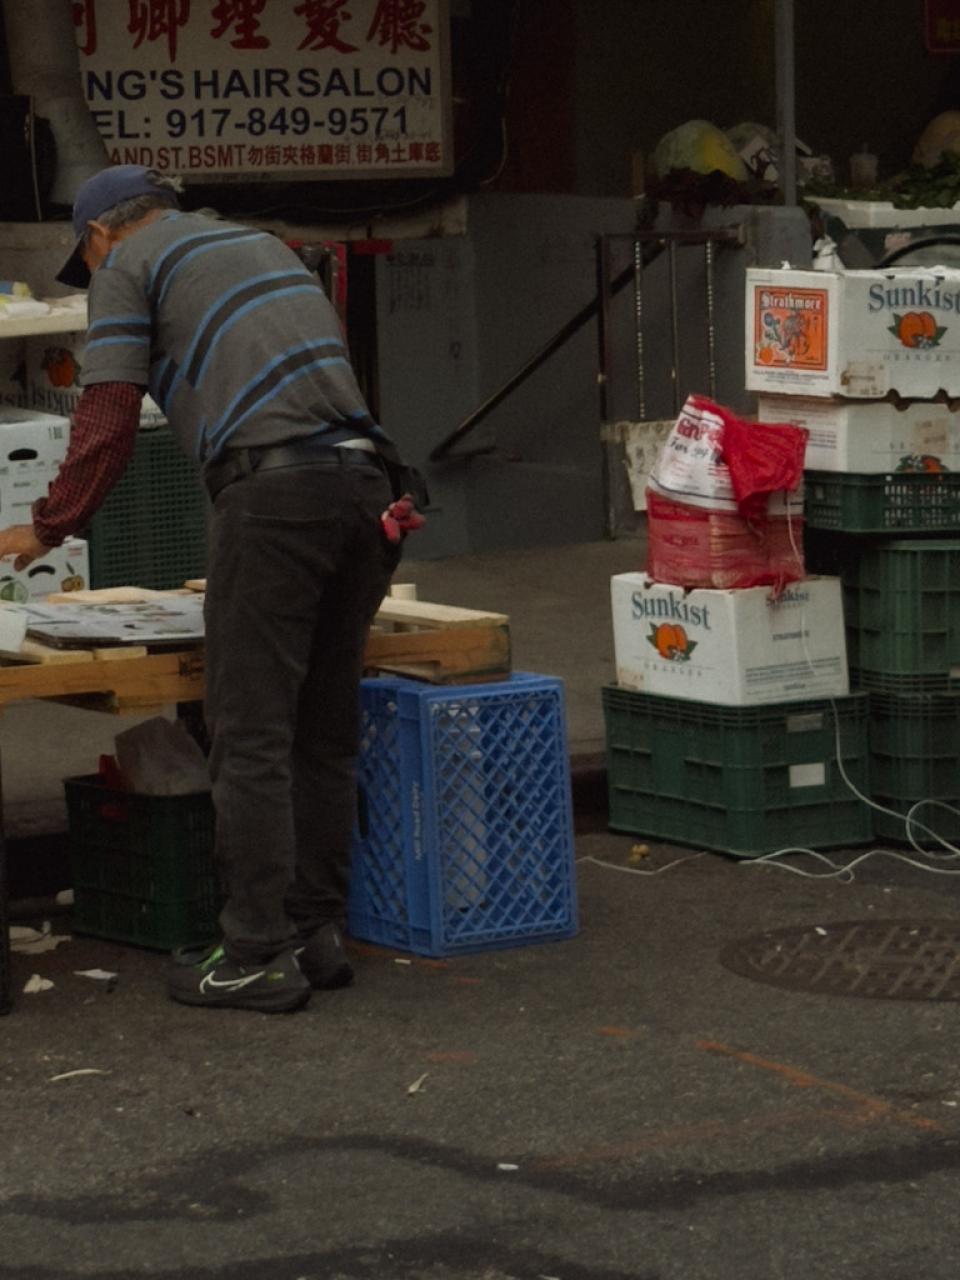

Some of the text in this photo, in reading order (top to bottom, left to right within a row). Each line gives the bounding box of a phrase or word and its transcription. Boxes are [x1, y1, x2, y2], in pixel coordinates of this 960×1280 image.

[86, 67, 432, 101] NG'S HAIR SALON
[95, 106, 409, 139] EL: 917-849-9571
[109, 145, 154, 167] AND
[868, 279, 960, 315] Sunkist
[32, 384, 79, 417] nkist
[631, 590, 711, 630] Sunkist
